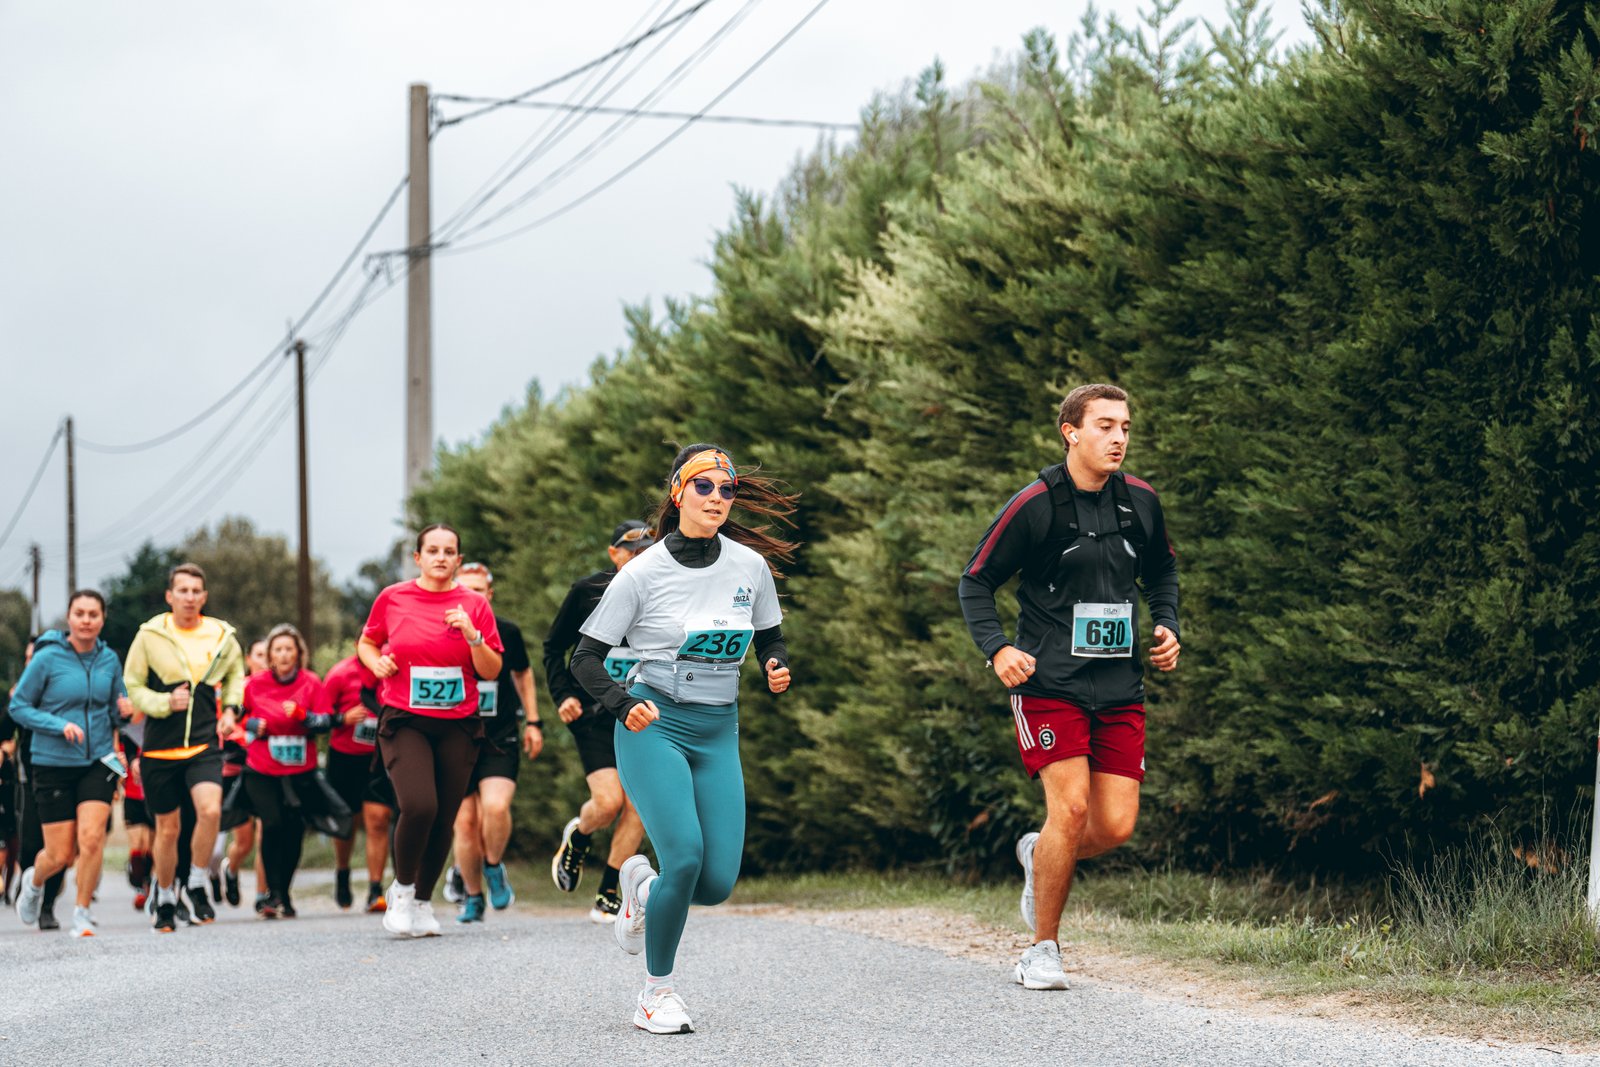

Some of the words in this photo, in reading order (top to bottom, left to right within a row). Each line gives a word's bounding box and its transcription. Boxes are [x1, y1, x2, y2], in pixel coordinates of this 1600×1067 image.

[687, 632, 743, 655] 236
[1086, 620, 1125, 646] 630
[419, 681, 457, 699] 527
